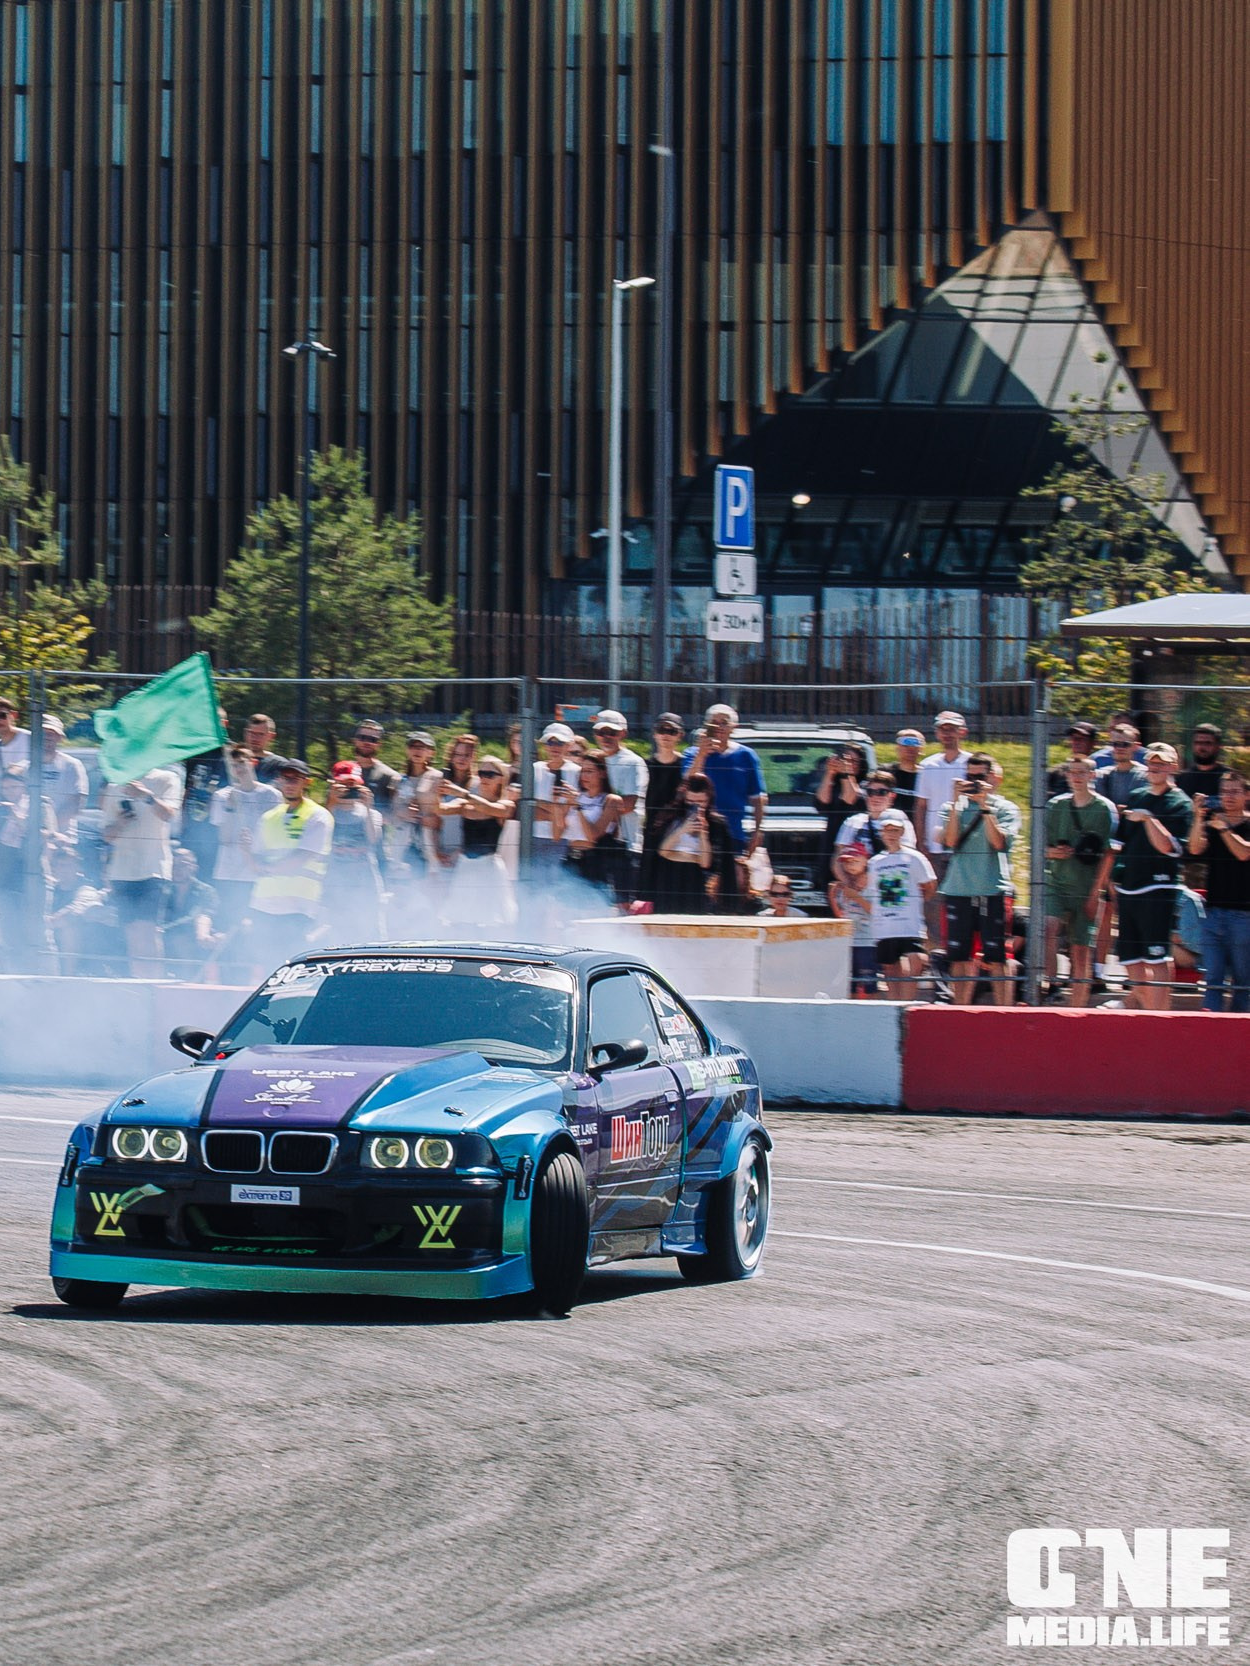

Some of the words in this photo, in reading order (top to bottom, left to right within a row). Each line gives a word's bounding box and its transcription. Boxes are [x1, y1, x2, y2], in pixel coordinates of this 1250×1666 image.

[725, 476, 748, 538] P
[268, 964, 306, 986] 36
[610, 1111, 670, 1164] ШинТорг
